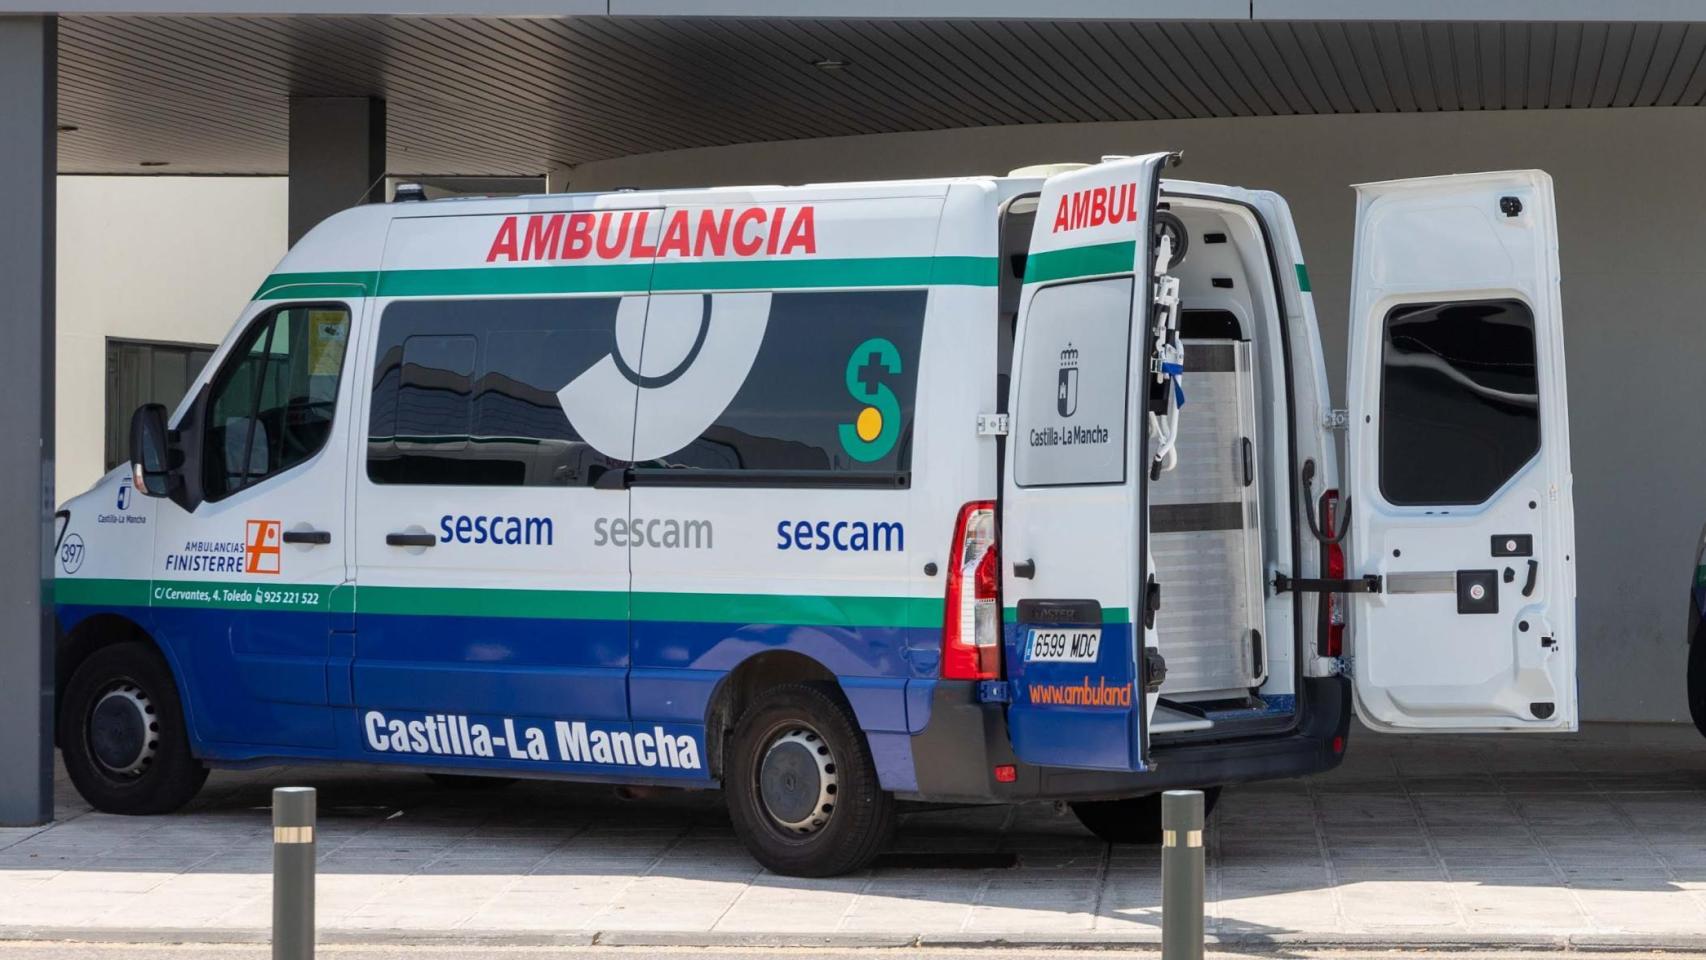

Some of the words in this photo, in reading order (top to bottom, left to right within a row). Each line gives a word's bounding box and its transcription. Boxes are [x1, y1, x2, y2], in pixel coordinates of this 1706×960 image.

[1053, 183, 1137, 234] AMBUL
[486, 206, 816, 262] AMBULANCIA
[1074, 425, 1108, 445] Mancha
[126, 515, 146, 524] Mancha
[440, 514, 553, 546] sescam
[594, 516, 713, 549] sescam
[777, 519, 904, 552] sescam
[62, 544, 83, 564] 397
[185, 541, 245, 553] AMBULANCIAS
[165, 555, 244, 572] FINISTERRE
[165, 588, 210, 602] Cervantes,
[213, 590, 221, 601] 4.
[223, 589, 252, 602] Toledo
[264, 592, 281, 604] 925
[284, 593, 299, 604] 221
[302, 593, 319, 604] 522
[1034, 633, 1066, 658] 6599
[1070, 633, 1097, 658] MDC
[364, 710, 549, 761] Castilla-La
[555, 720, 701, 769] Mancha
